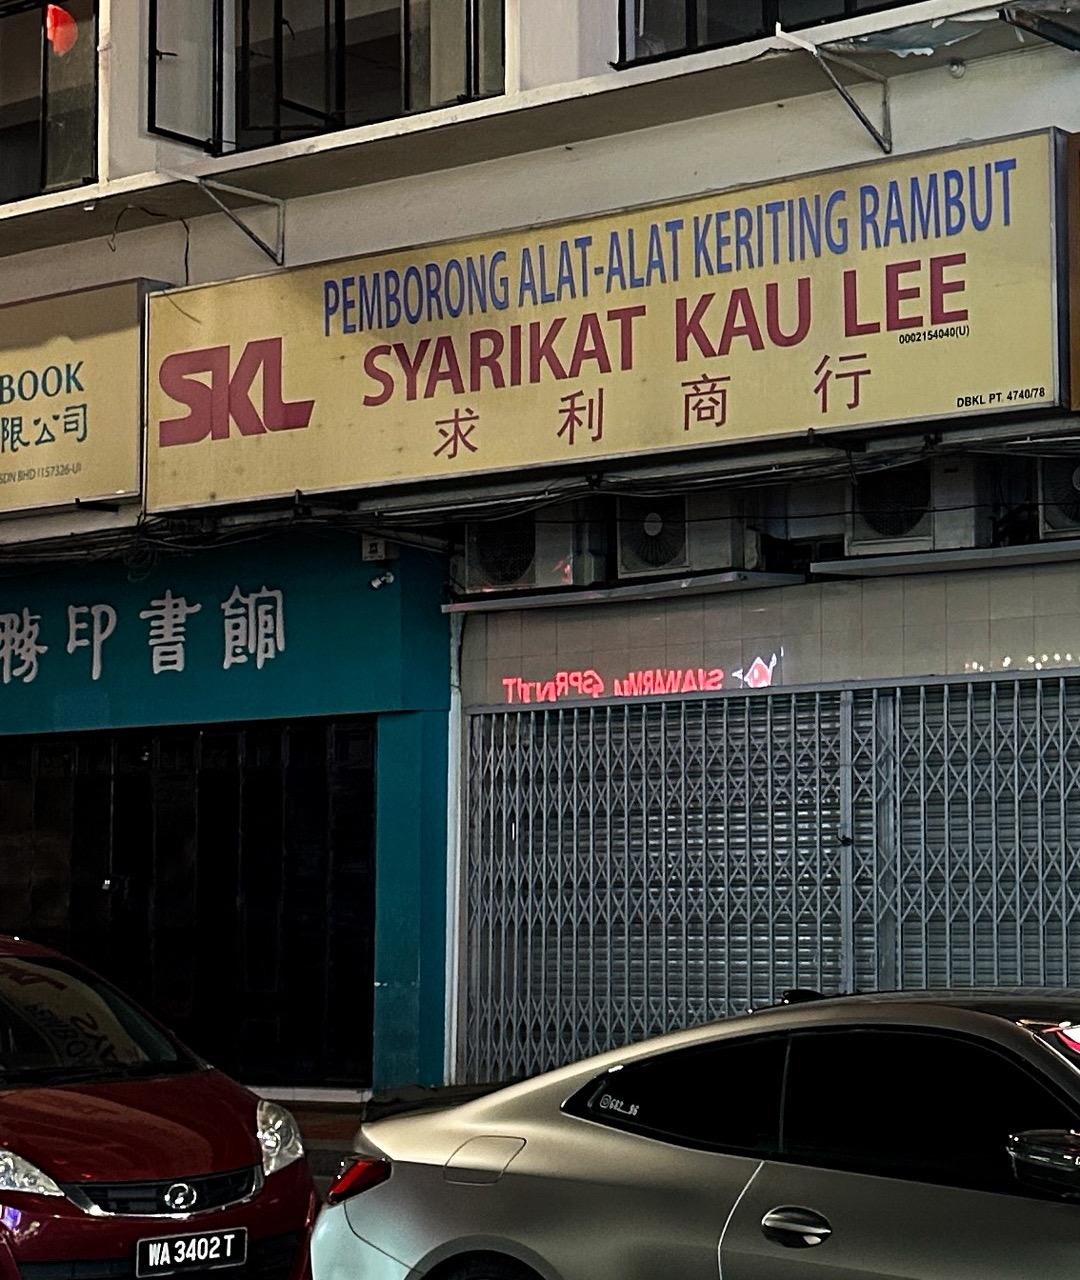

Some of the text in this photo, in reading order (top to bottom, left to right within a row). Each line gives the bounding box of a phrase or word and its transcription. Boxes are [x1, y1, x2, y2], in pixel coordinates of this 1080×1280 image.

[323, 158, 1017, 337] PEMBORONG ALAT-ALAT KERITING RAMBUT
[363, 252, 969, 407] SYARIKAT KAU LEE
[899, 325, 970, 344] 0002154040(U)
[0, 360, 85, 406] BOOK
[159, 336, 316, 448] SKL
[433, 353, 872, 460] 求利商行
[956, 394, 986, 408] DBKL
[1006, 386, 1046, 401] 4740/78
[148, 1233, 236, 1266] WA 3402 T
